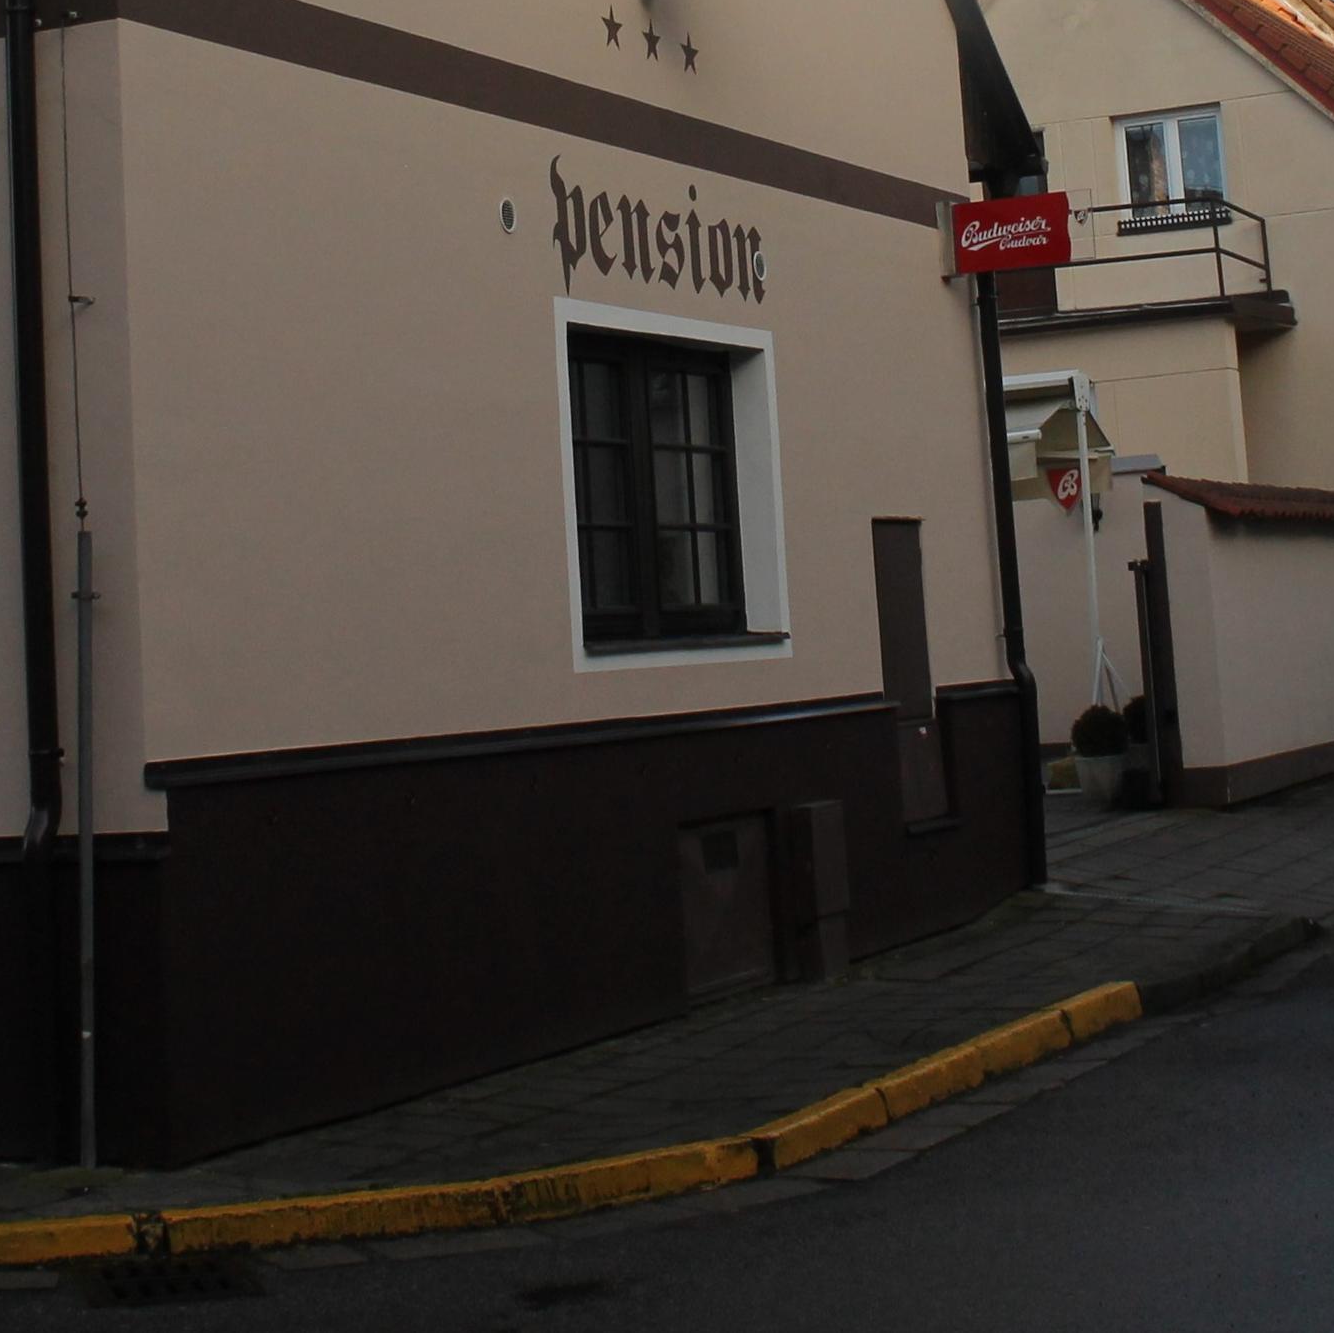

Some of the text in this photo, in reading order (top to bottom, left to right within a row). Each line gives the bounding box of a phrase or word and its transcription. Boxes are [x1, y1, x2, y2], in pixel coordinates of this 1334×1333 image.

[549, 154, 767, 305] pension
[961, 216, 1051, 248] Budweiser
[999, 233, 1048, 251] Budvar
